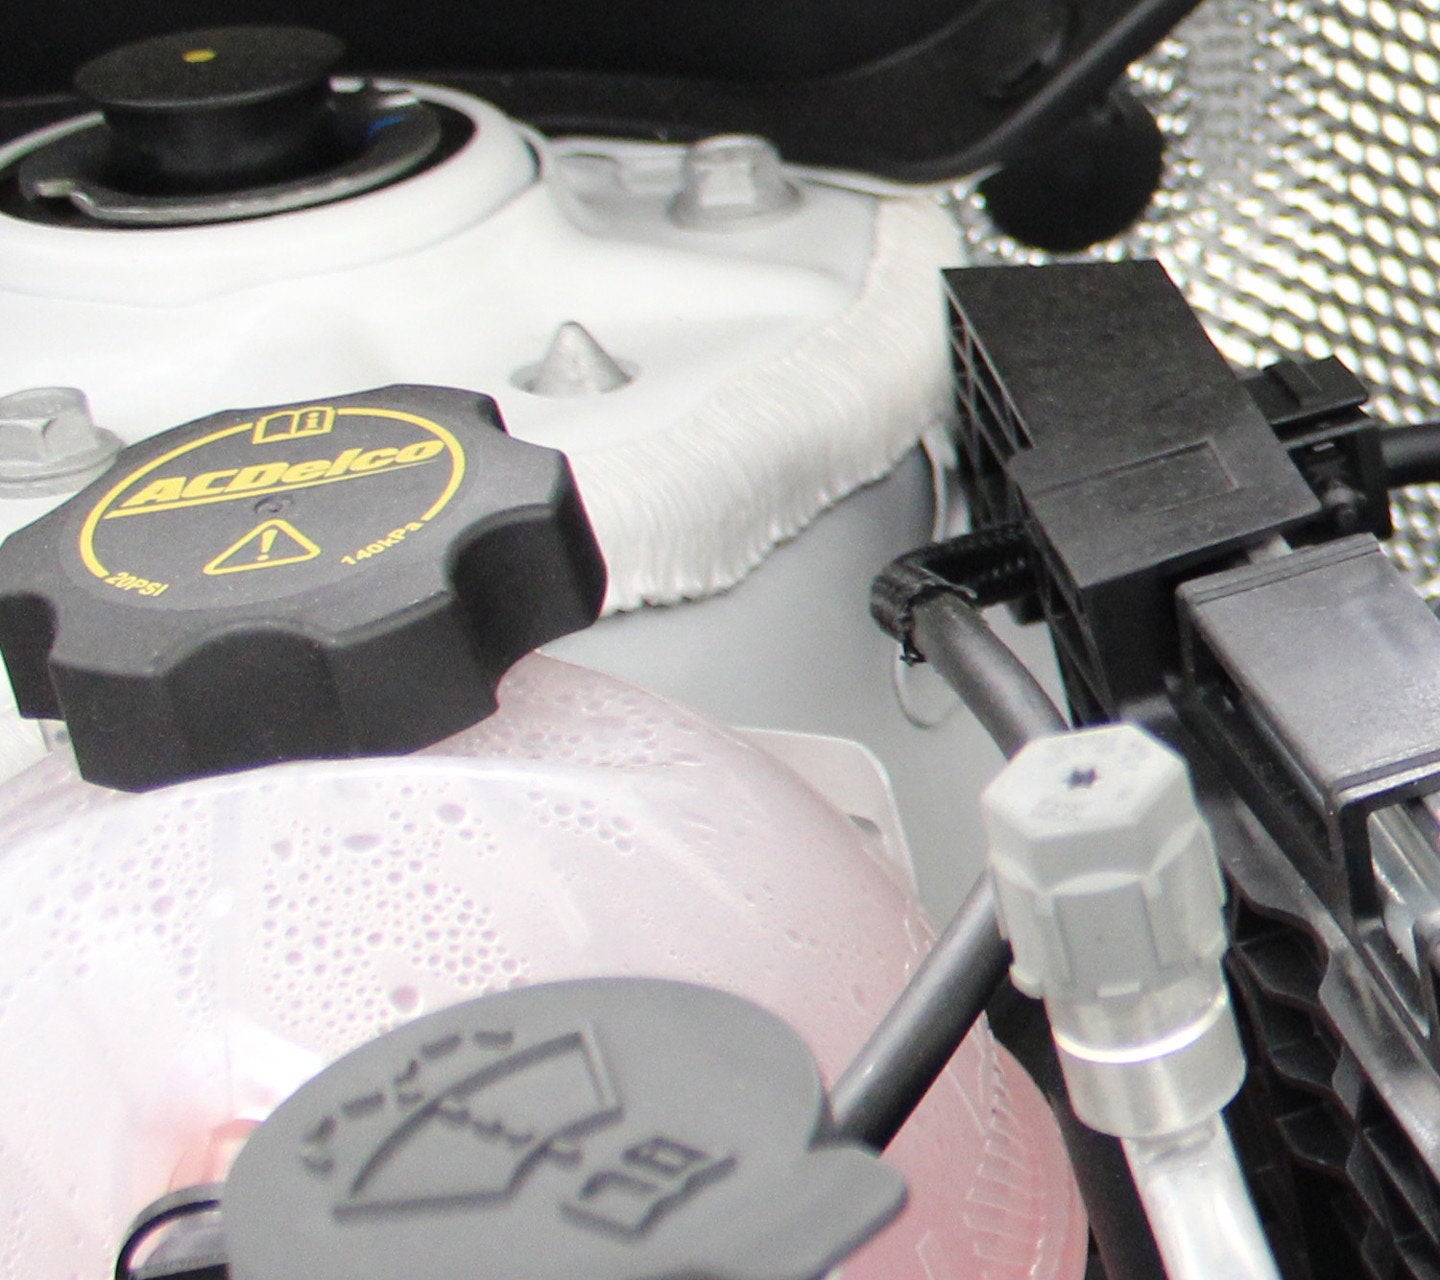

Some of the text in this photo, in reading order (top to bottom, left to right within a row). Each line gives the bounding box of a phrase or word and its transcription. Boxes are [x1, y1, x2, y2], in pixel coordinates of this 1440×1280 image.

[119, 439, 447, 508] ACDelco
[340, 521, 424, 567] 140kPa
[104, 571, 170, 597] 20PSI
